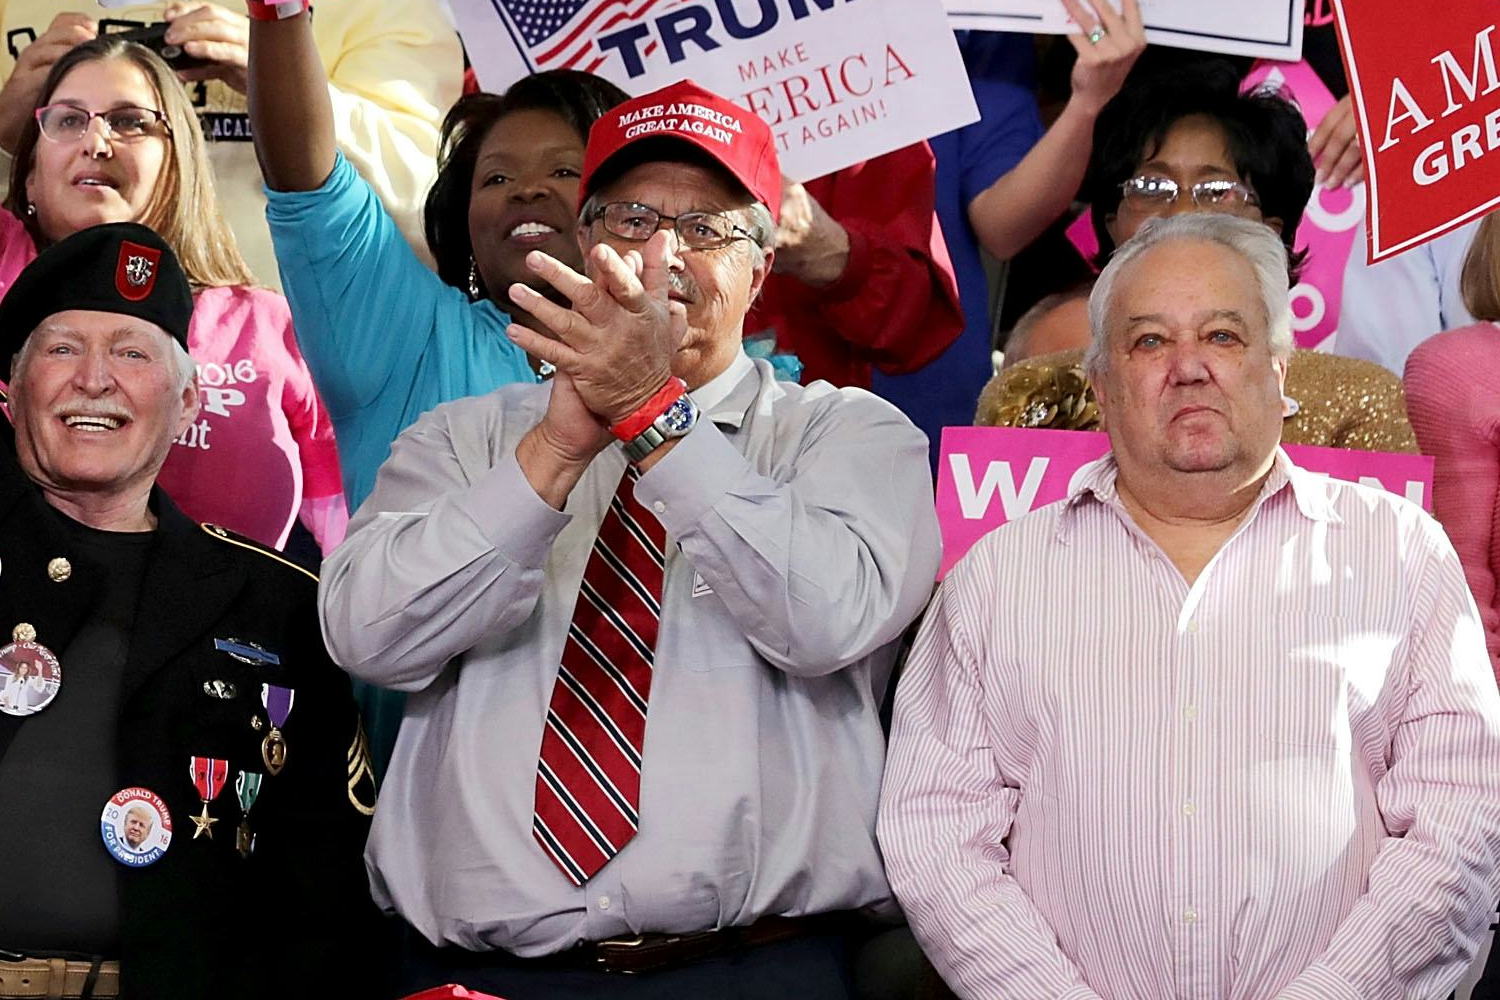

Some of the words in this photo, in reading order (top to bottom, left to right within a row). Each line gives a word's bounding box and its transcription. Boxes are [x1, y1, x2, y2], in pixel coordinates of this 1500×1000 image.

[738, 43, 808, 82] MAKE
[741, 43, 916, 127] ERICA
[618, 105, 664, 128] MAKE
[666, 103, 743, 133] AMERICA
[626, 119, 678, 139] GREAT
[678, 120, 732, 144] AGAIN
[801, 103, 888, 144] AGAIN!
[116, 789, 151, 803] DONALD
[152, 796, 171, 825] TRUMP
[105, 826, 116, 846] FOR
[113, 847, 160, 864] PRESIDENT
[106, 808, 118, 819] 20
[161, 835, 168, 845] 16
